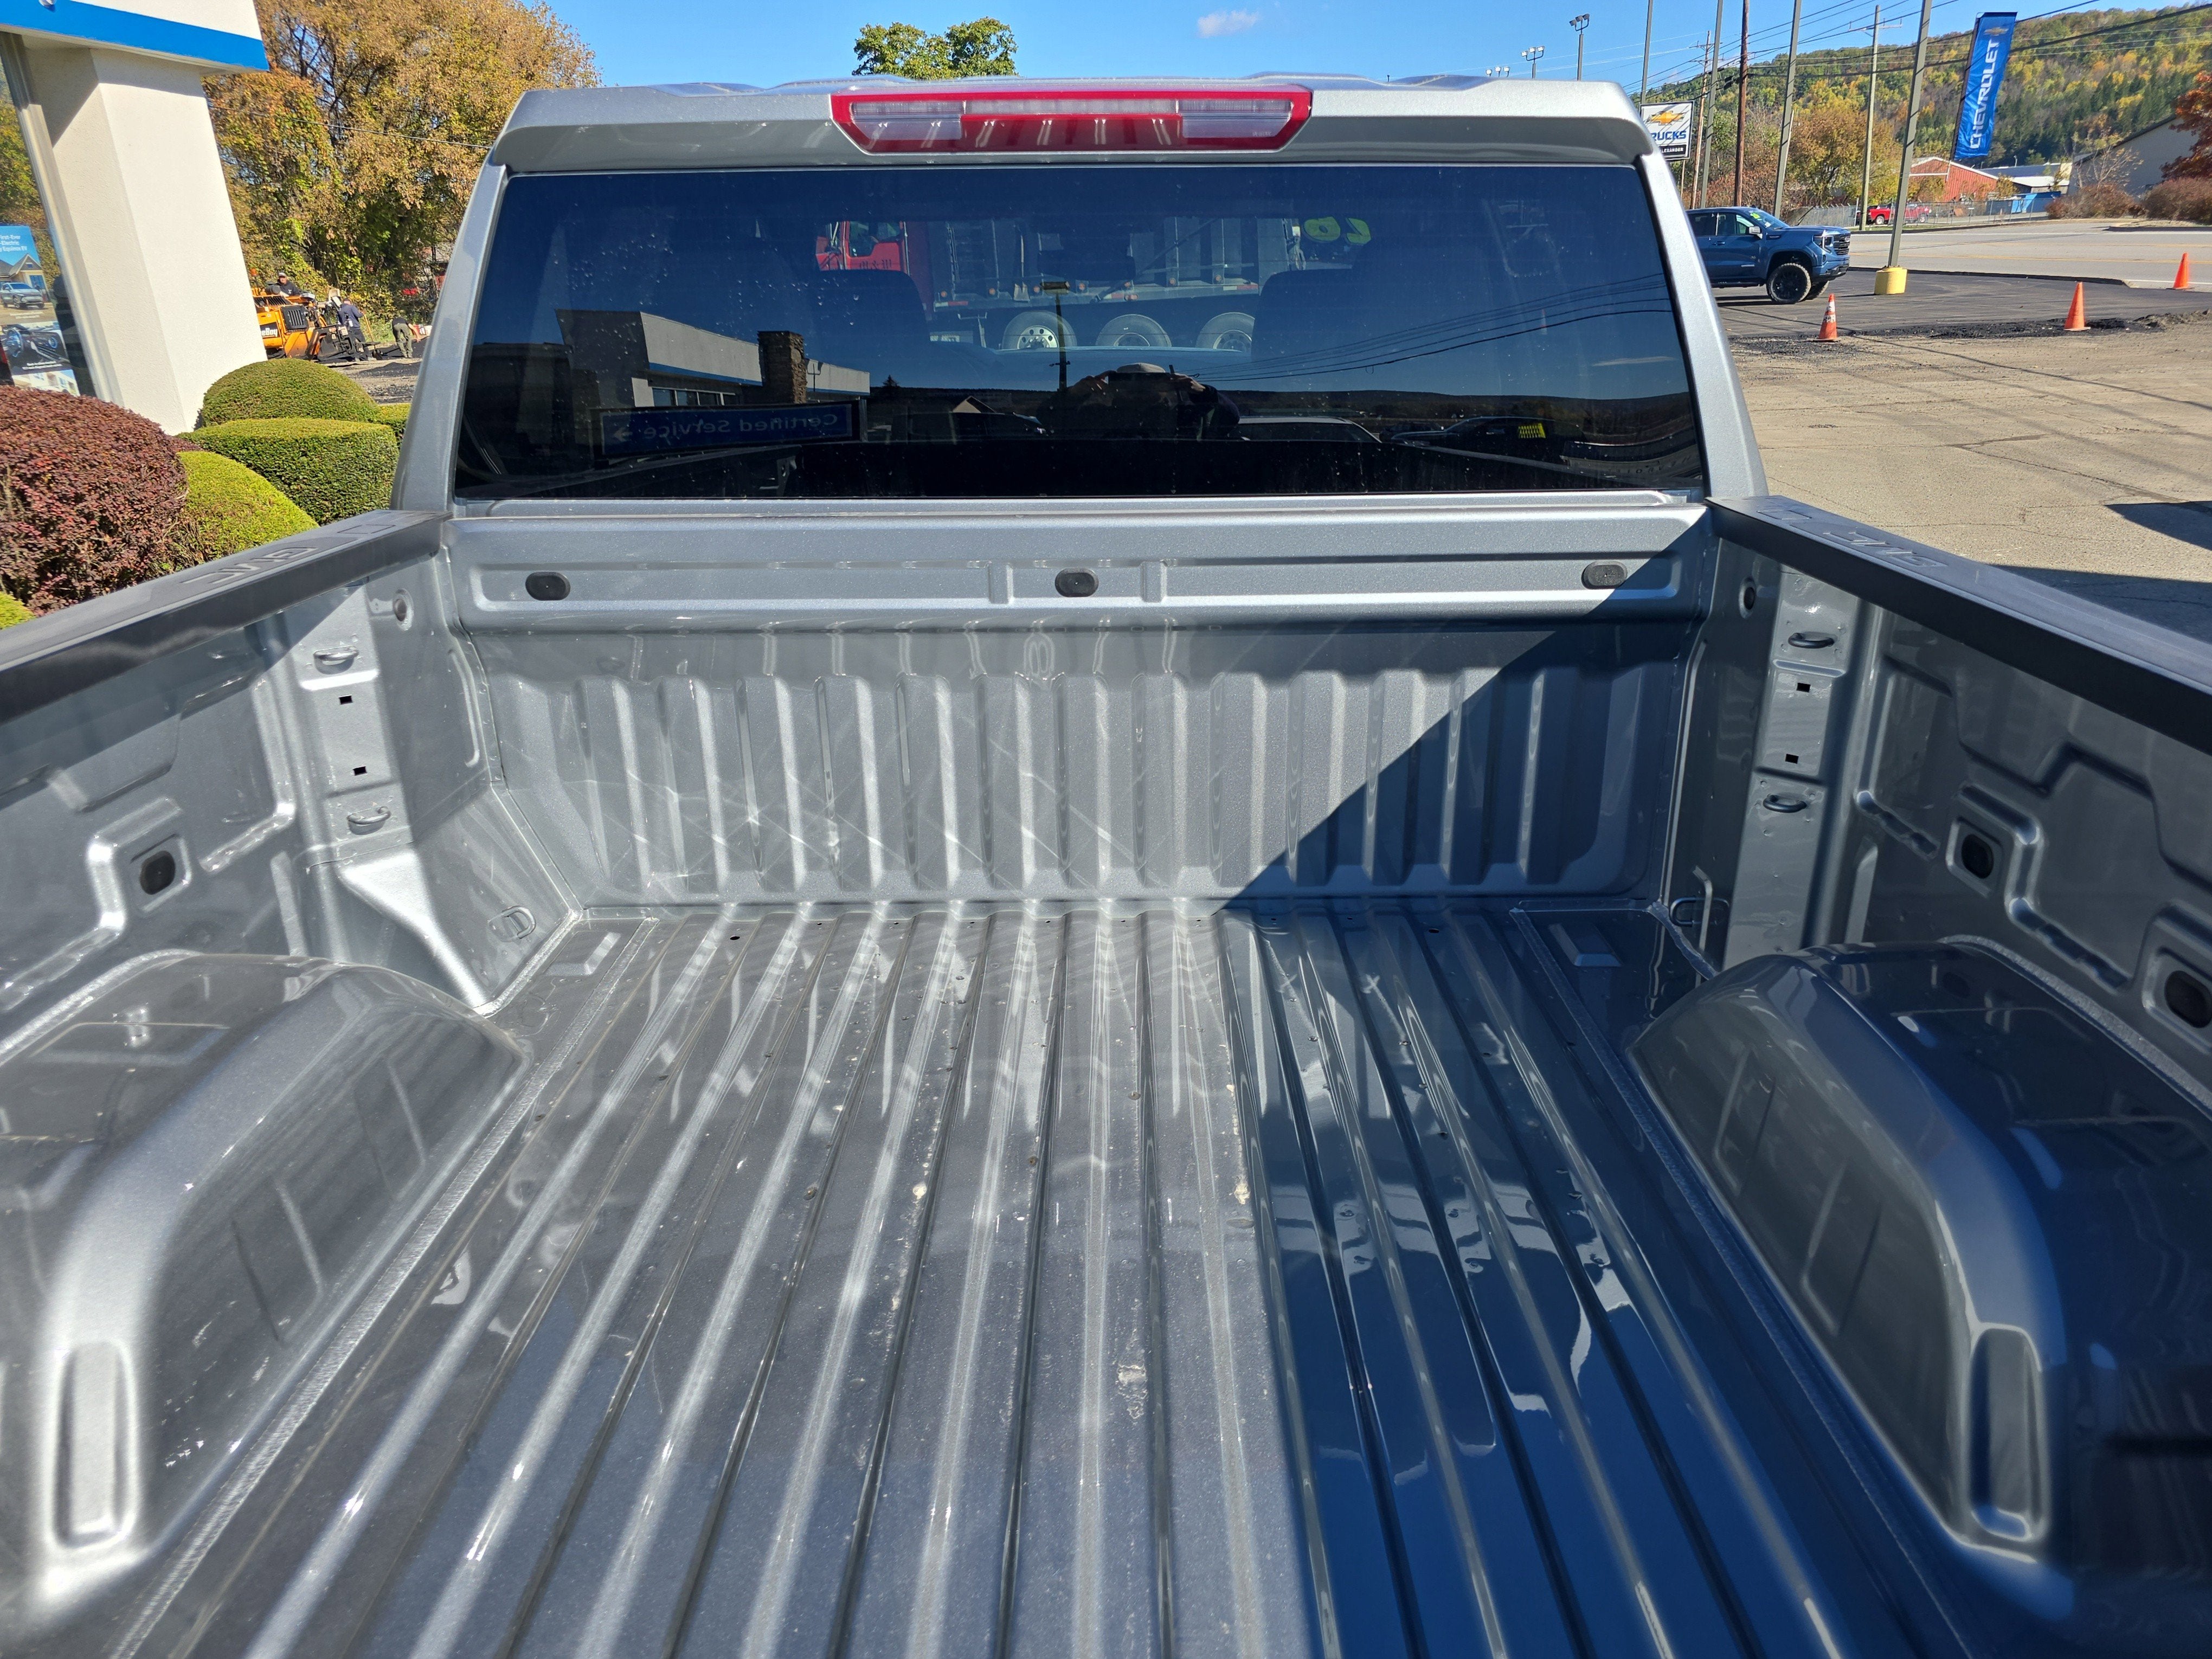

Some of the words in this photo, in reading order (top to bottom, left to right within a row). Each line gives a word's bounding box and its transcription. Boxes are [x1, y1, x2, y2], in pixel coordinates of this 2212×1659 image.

[1970, 39, 1999, 149] CHEVROLET
[1650, 130, 1687, 141] RUCKS
[261, 327, 278, 337] eBoy
